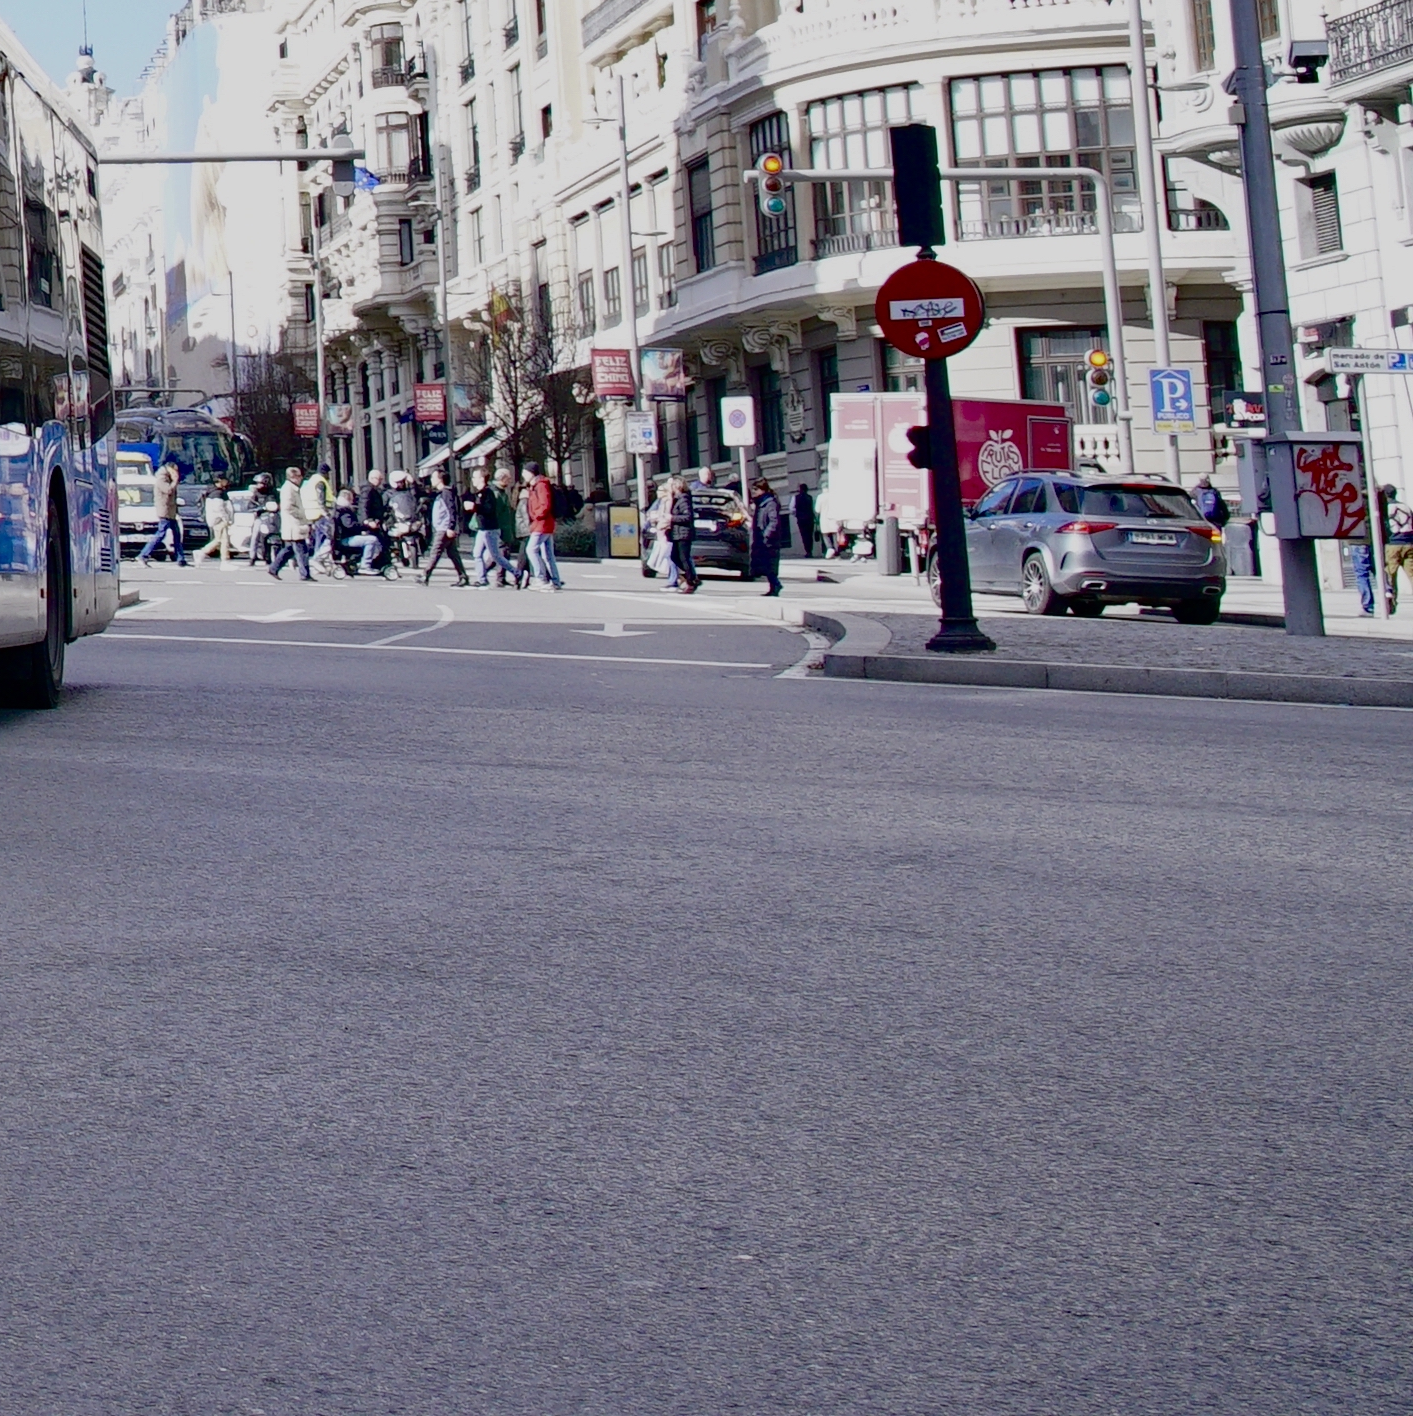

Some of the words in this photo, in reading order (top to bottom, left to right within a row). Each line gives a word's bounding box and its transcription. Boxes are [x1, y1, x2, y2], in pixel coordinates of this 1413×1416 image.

[1333, 352, 1371, 360] mercado
[1374, 352, 1385, 360] de
[595, 356, 628, 367] FELIZ
[1334, 361, 1351, 369] San
[1354, 361, 1381, 369] Antón
[596, 372, 630, 383] CHINO
